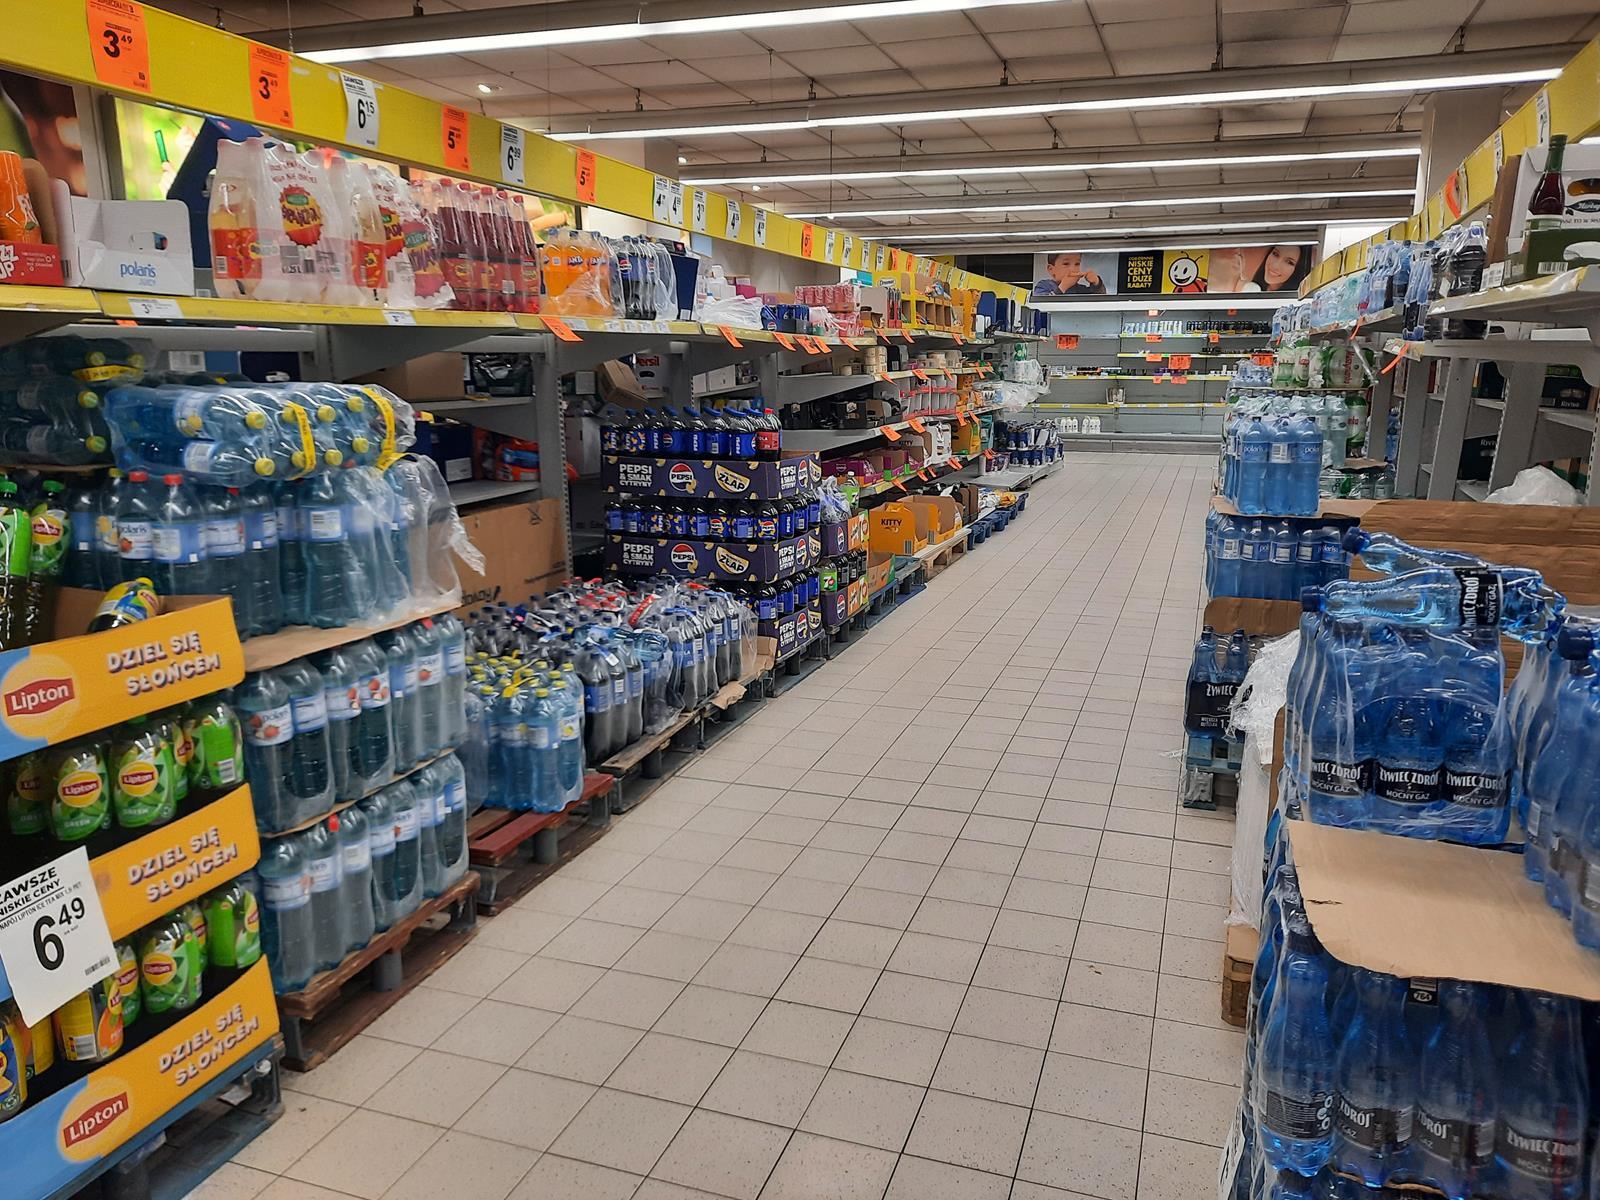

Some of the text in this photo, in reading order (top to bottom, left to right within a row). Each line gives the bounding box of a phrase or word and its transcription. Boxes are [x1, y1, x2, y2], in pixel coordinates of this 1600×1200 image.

[104, 30, 132, 58] 3 49
[259, 76, 270, 100] 3
[358, 98, 374, 128] 6 15
[448, 130, 456, 150] 5
[507, 146, 514, 170] 6
[580, 170, 586, 186] 5
[656, 194, 662, 206] 4
[672, 196, 677, 215] 4
[120, 261, 156, 278] polaris
[1128, 260, 1154, 268] NISKIE
[1128, 268, 1152, 276] CENY
[620, 464, 652, 474] PEPSI
[627, 474, 652, 482] SMAK
[780, 466, 796, 476] PEPSI
[718, 472, 745, 492] ZŁAP
[623, 543, 654, 553] PEPSI
[630, 553, 654, 561] SMAK
[779, 546, 794, 556] PEPSI
[719, 554, 745, 572] ZŁAP
[1488, 584, 1498, 600] GAZ
[1461, 576, 1479, 628] YWIEC ZDRÓJ
[780, 621, 794, 632] PEPSI
[106, 631, 202, 673] DZIEL SIĘ
[126, 654, 222, 696] SŁOŃCEM
[11, 683, 70, 712] Lipton
[1206, 683, 1234, 696] ŻYWIEC
[124, 774, 153, 784] Lipton
[1312, 762, 1364, 780] WIEC ZDRÓJ
[1380, 766, 1440, 786] ŻYWIEC ZDRÓJ
[1446, 772, 1478, 787] ŻYWIEC
[64, 782, 98, 795] Lipton
[1334, 785, 1350, 793] GAZ
[1386, 790, 1414, 800] MOCNY
[1453, 794, 1482, 805] MOCNY
[128, 826, 222, 885] DZIEL SIĘ
[148, 843, 239, 902] SŁOŃCEM
[0, 867, 57, 905] AWSZE
[0, 879, 60, 916] NISKIE CENY
[18, 908, 37, 920] LIPTON
[32, 915, 64, 970] 6
[59, 897, 85, 925] 49
[158, 1003, 245, 1074] DZIEL SIĘ
[175, 1014, 260, 1087] SŁOŃCEM
[69, 1096, 124, 1140] Lipton
[1506, 1127, 1549, 1154] ŻYWIEC
